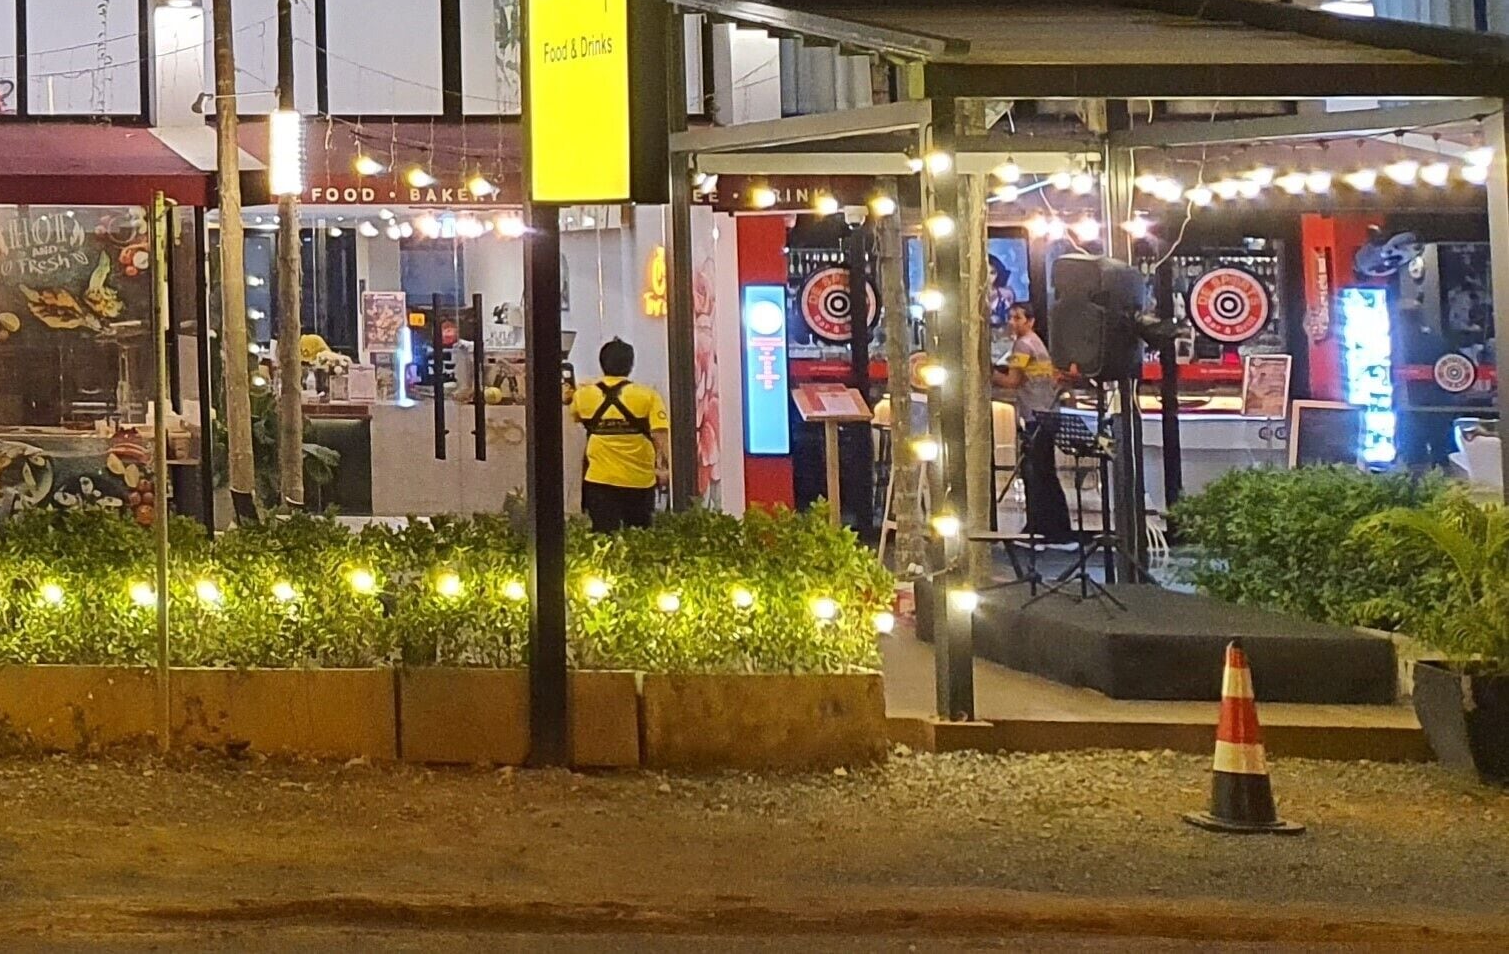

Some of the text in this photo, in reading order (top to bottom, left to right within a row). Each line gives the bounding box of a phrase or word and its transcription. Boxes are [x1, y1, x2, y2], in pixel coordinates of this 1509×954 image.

[544, 32, 614, 64] Food & Drinks
[311, 188, 499, 202] FOOD BAKEY
[8, 212, 70, 249] HOT
[31, 245, 58, 257] AND
